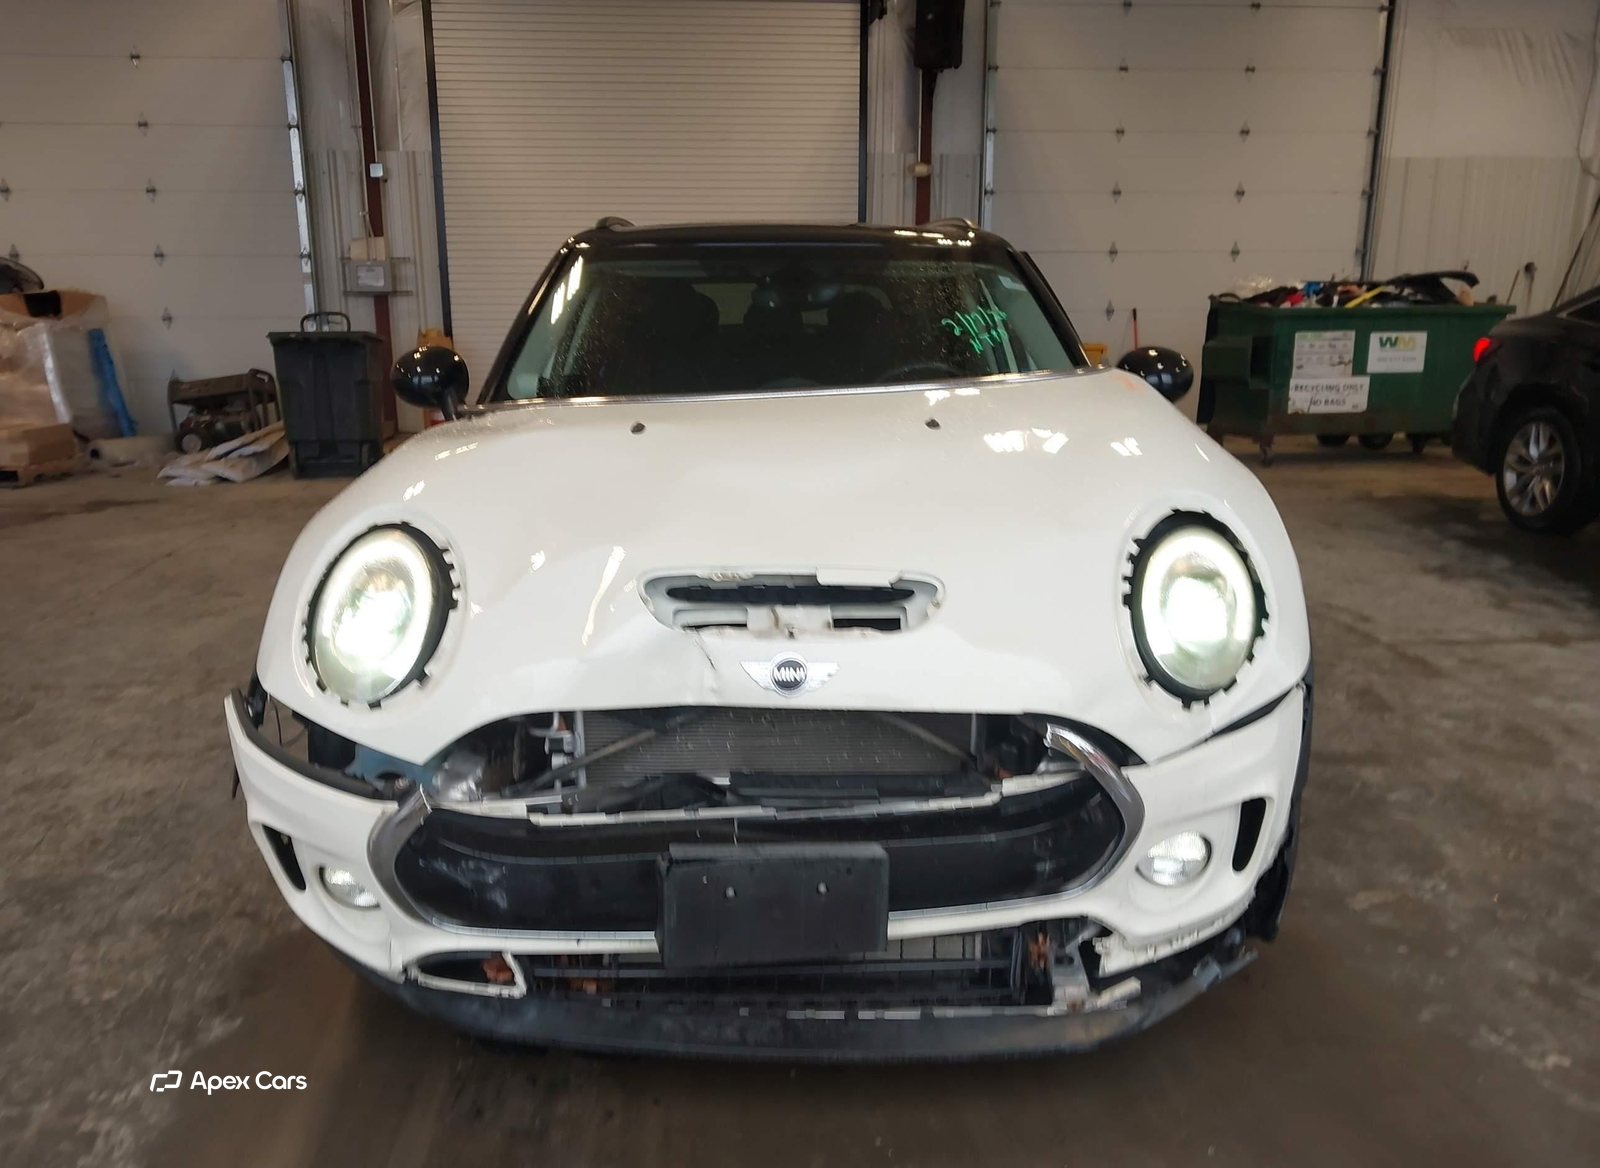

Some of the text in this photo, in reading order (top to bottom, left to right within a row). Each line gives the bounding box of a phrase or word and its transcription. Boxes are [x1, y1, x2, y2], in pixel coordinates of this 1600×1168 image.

[1379, 336, 1416, 350] WM
[1294, 383, 1364, 393] RECYCLING ONLY
[1324, 398, 1346, 406] BAGS
[773, 666, 806, 682] MINI
